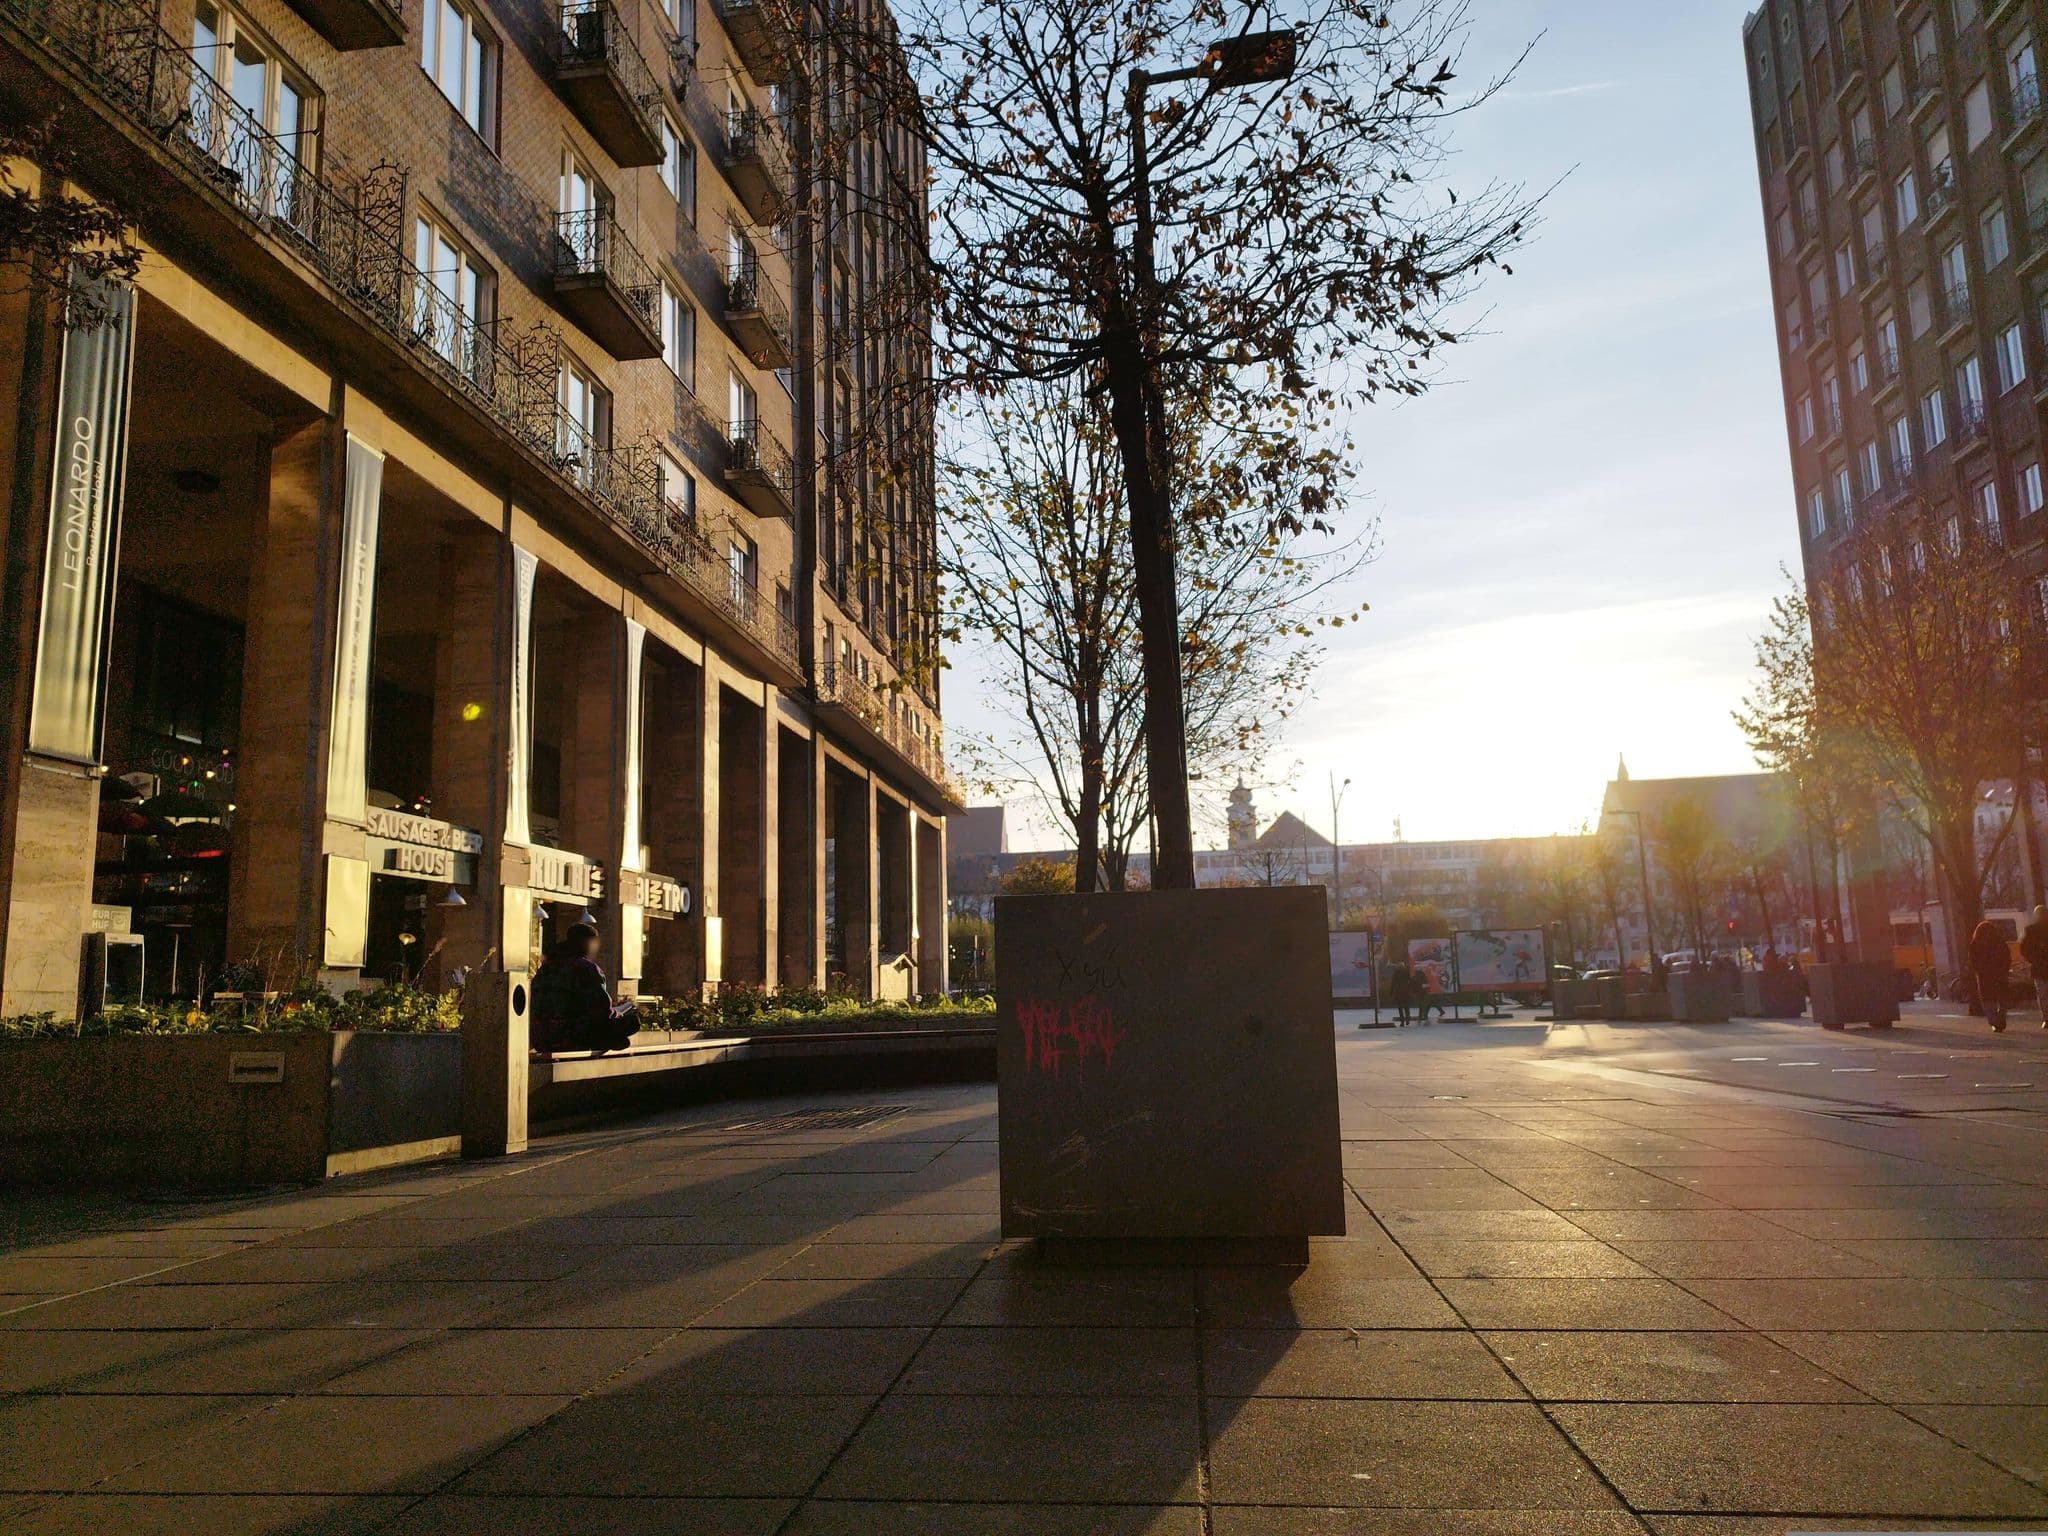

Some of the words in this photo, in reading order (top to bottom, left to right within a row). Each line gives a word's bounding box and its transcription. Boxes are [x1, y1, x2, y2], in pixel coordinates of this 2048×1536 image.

[90, 460, 104, 500] Hotel
[62, 416, 92, 590] LEONARDO
[86, 503, 102, 566] Boutique
[366, 811, 439, 847] SAUSAGE
[440, 826, 451, 849] &
[452, 828, 483, 854] BEER
[400, 848, 455, 876] HOUSE
